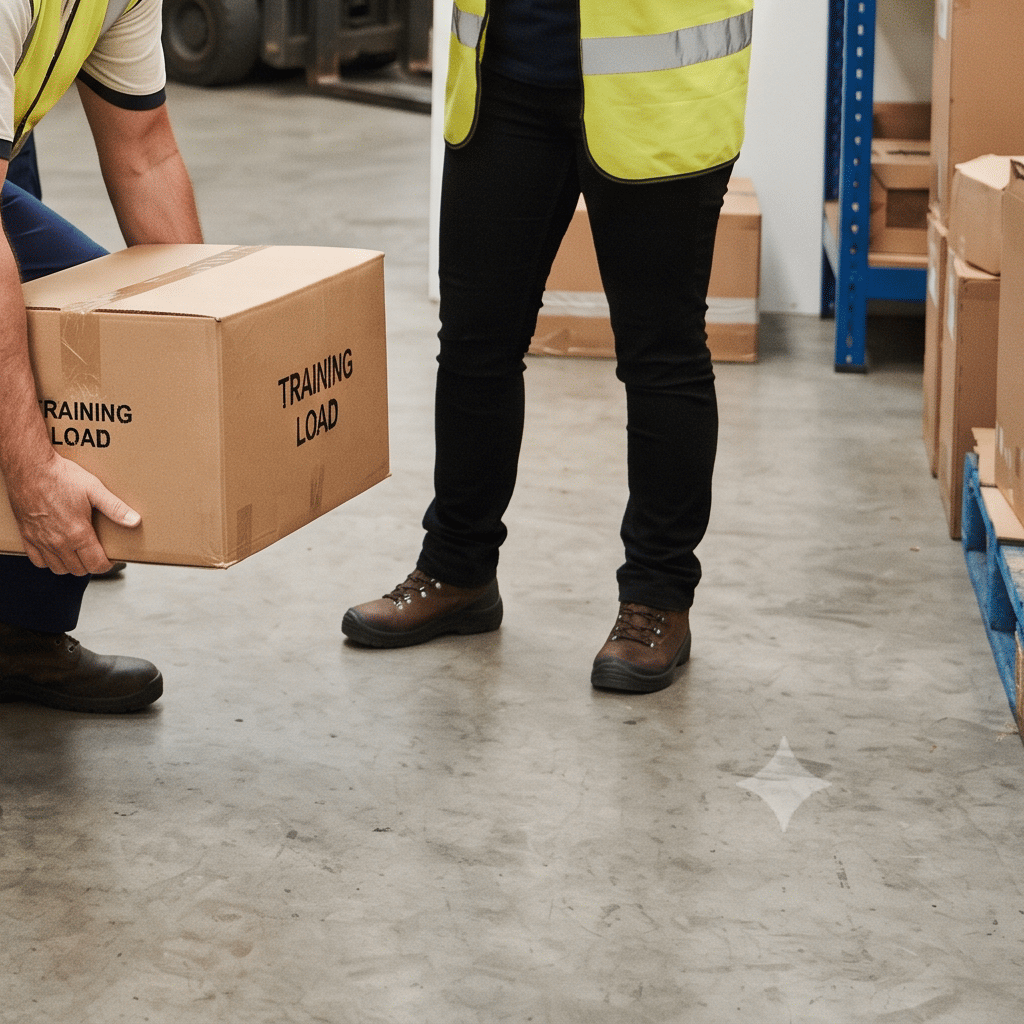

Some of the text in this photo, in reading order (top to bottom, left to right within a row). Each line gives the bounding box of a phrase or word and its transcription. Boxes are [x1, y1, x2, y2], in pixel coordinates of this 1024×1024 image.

[277, 348, 354, 409] TRAINING
[38, 399, 133, 424] RAINING
[295, 398, 339, 447] LOAD
[51, 426, 111, 449] LOAD
